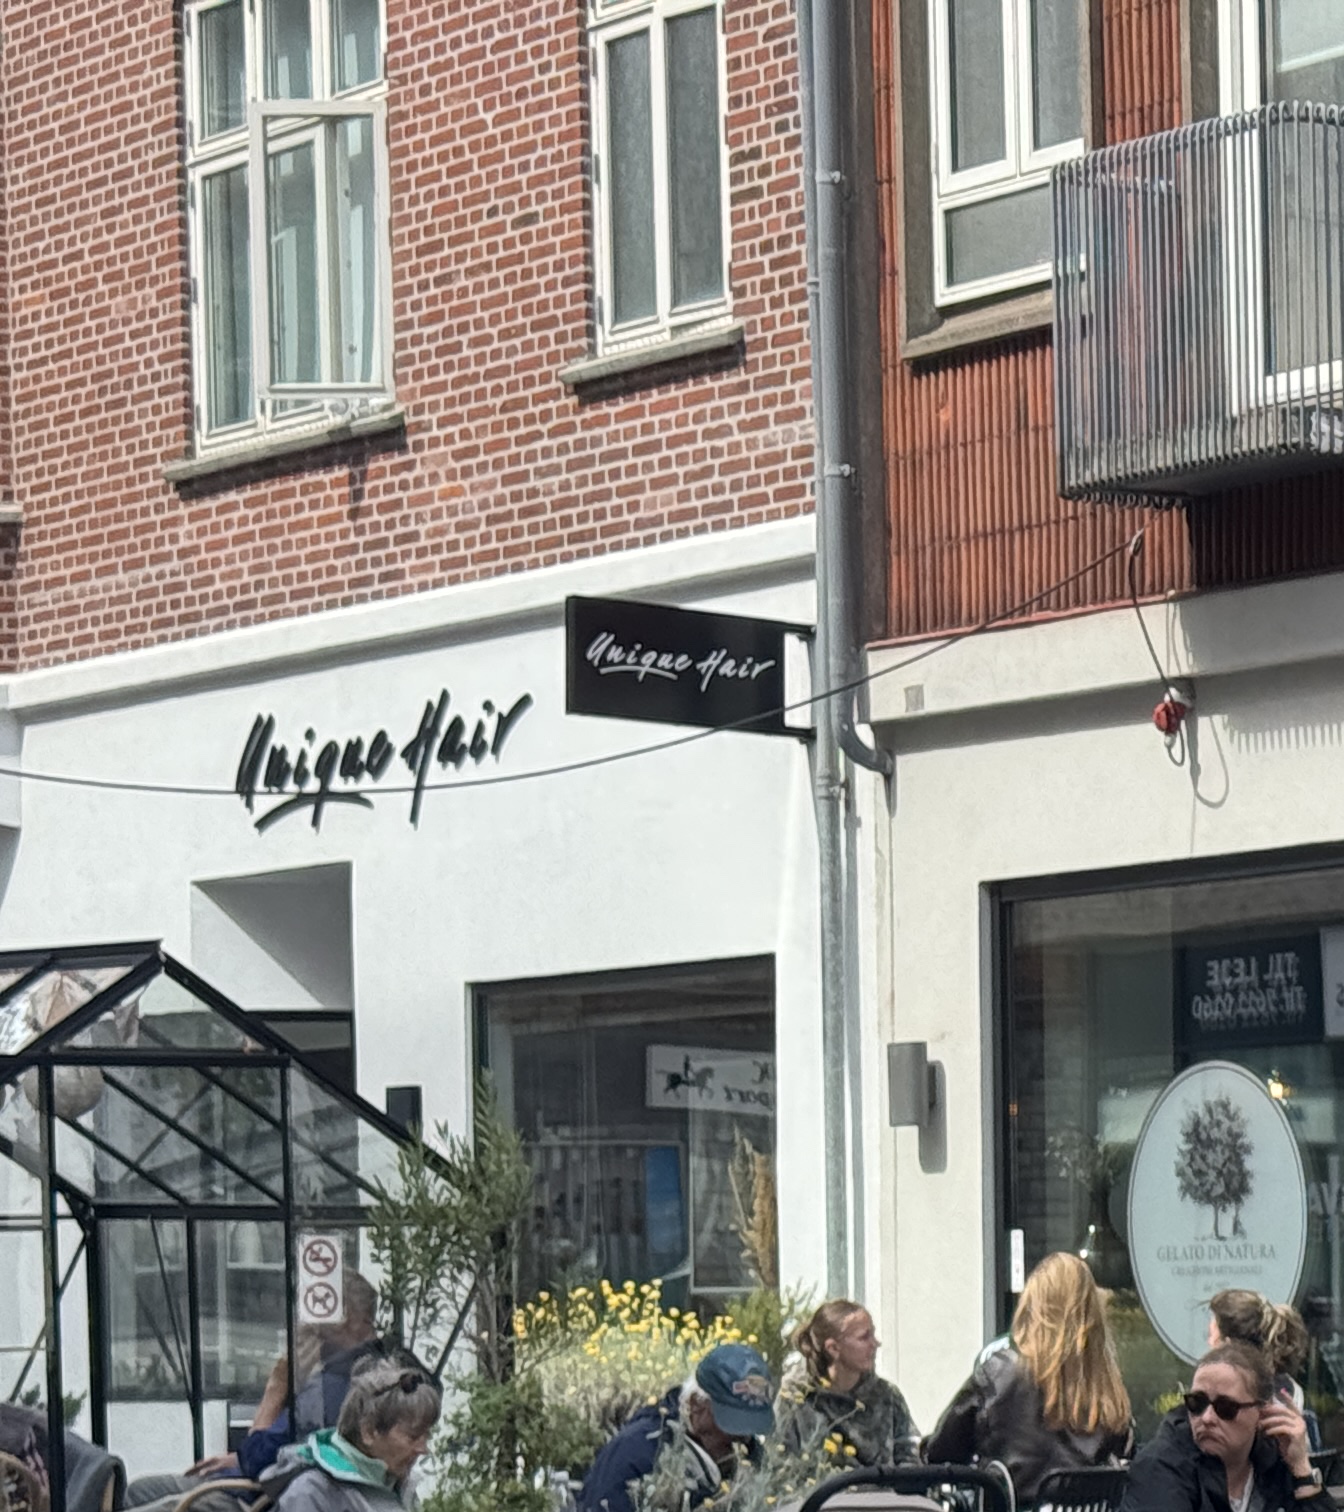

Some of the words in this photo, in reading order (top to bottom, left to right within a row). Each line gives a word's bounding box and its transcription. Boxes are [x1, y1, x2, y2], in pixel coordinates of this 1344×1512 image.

[583, 632, 692, 680] Unique
[695, 651, 777, 692] Hair
[235, 713, 395, 835] Unique
[401, 688, 534, 830] Hair
[1157, 1246, 1204, 1262] GELATO
[1224, 1243, 1277, 1260] NATURA
